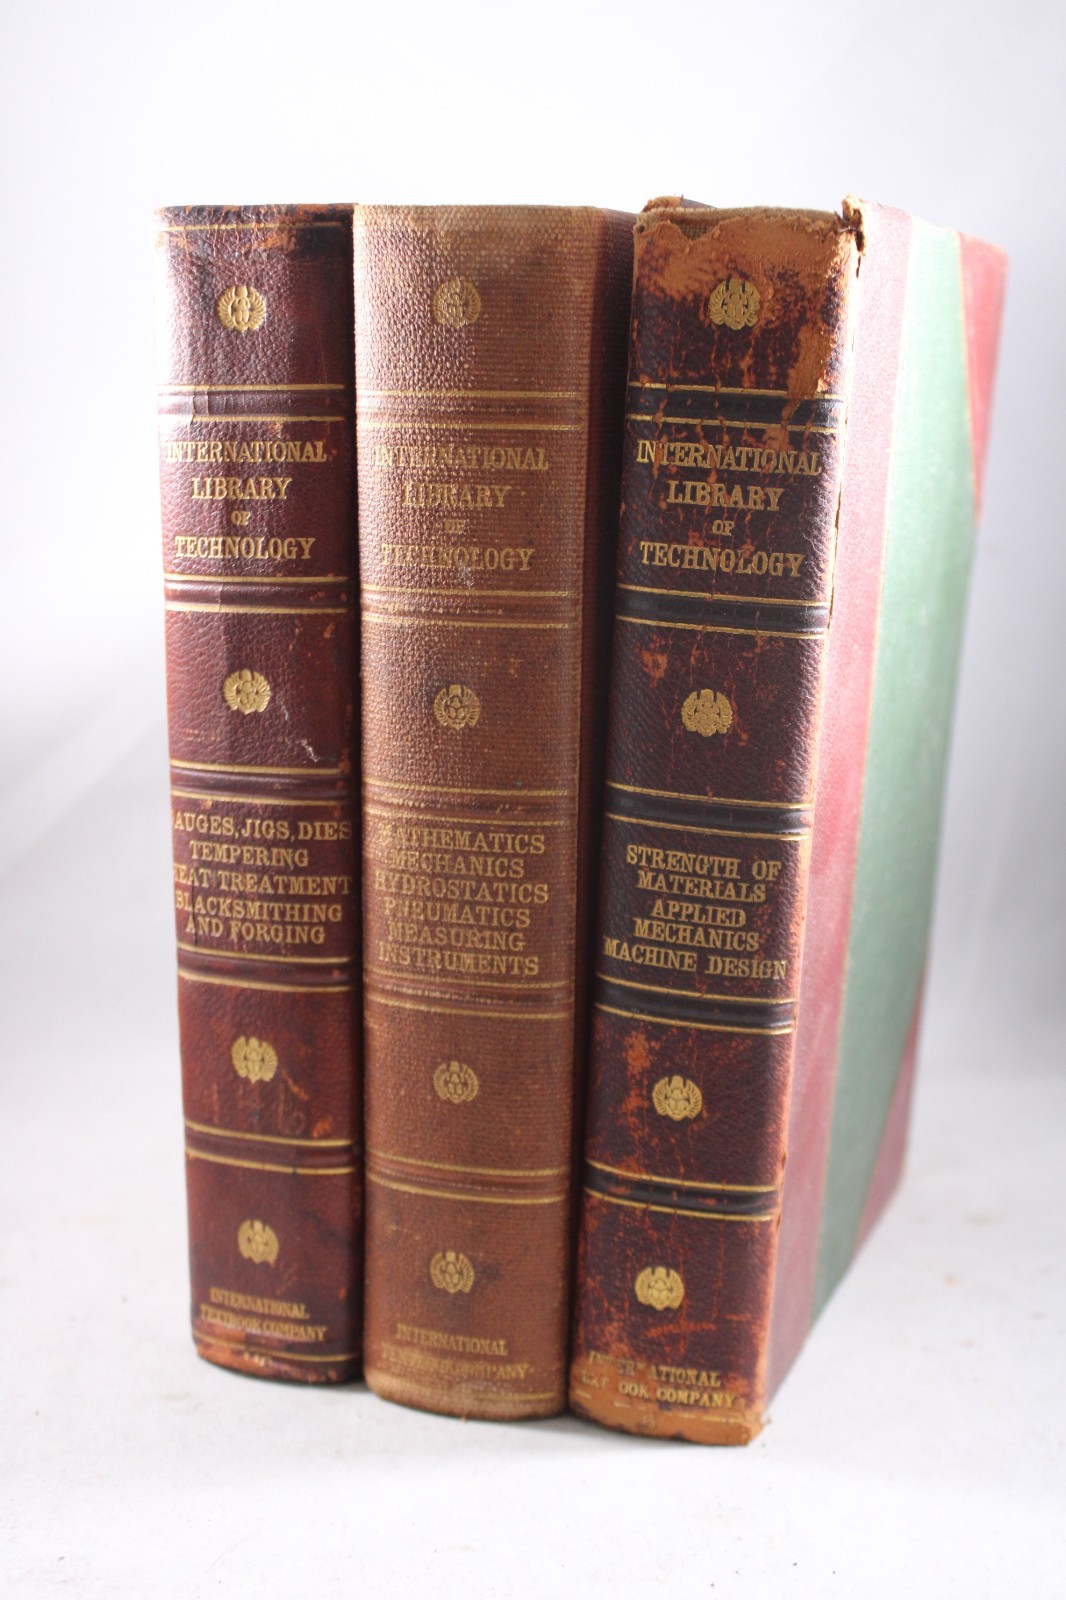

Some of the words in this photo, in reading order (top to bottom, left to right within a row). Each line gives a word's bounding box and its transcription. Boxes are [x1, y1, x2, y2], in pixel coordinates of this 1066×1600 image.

[166, 441, 327, 463] INTERNATIONAL
[374, 446, 549, 470] INTERNATIONAL
[636, 439, 822, 476] INTERNATIONAL
[191, 477, 292, 499] LIBRARY
[402, 482, 511, 508] LIBRARY
[666, 480, 784, 511] LIBRARY
[231, 510, 251, 526] OF
[712, 519, 735, 536] OF
[175, 536, 315, 559] TECHNOLOGY
[381, 543, 535, 571] TECHNOLOGY
[639, 541, 806, 578] TECHNOLOGY
[298, 821, 352, 841] DIES
[189, 840, 309, 867] TEMPERING
[389, 849, 524, 879] MECHANICS
[626, 844, 741, 878] STRENGTH
[752, 860, 782, 881] OF
[218, 870, 352, 896] TREATMENT
[374, 869, 549, 904] HYDROSTATICS
[635, 870, 766, 903] MATERIALS
[175, 890, 343, 923] BLACKSMITHING
[384, 897, 531, 928] PNEUMATICS
[651, 899, 747, 928] APPLIED
[186, 917, 224, 938] AND
[230, 920, 325, 945] FORGING
[387, 921, 526, 952] MEASURING
[632, 917, 760, 952] MECHANICS
[377, 942, 539, 976] INSTRUMENTS
[603, 936, 698, 972] MACHINE
[705, 955, 787, 980] DESIGN
[656, 1386, 738, 1409] COMPANY
